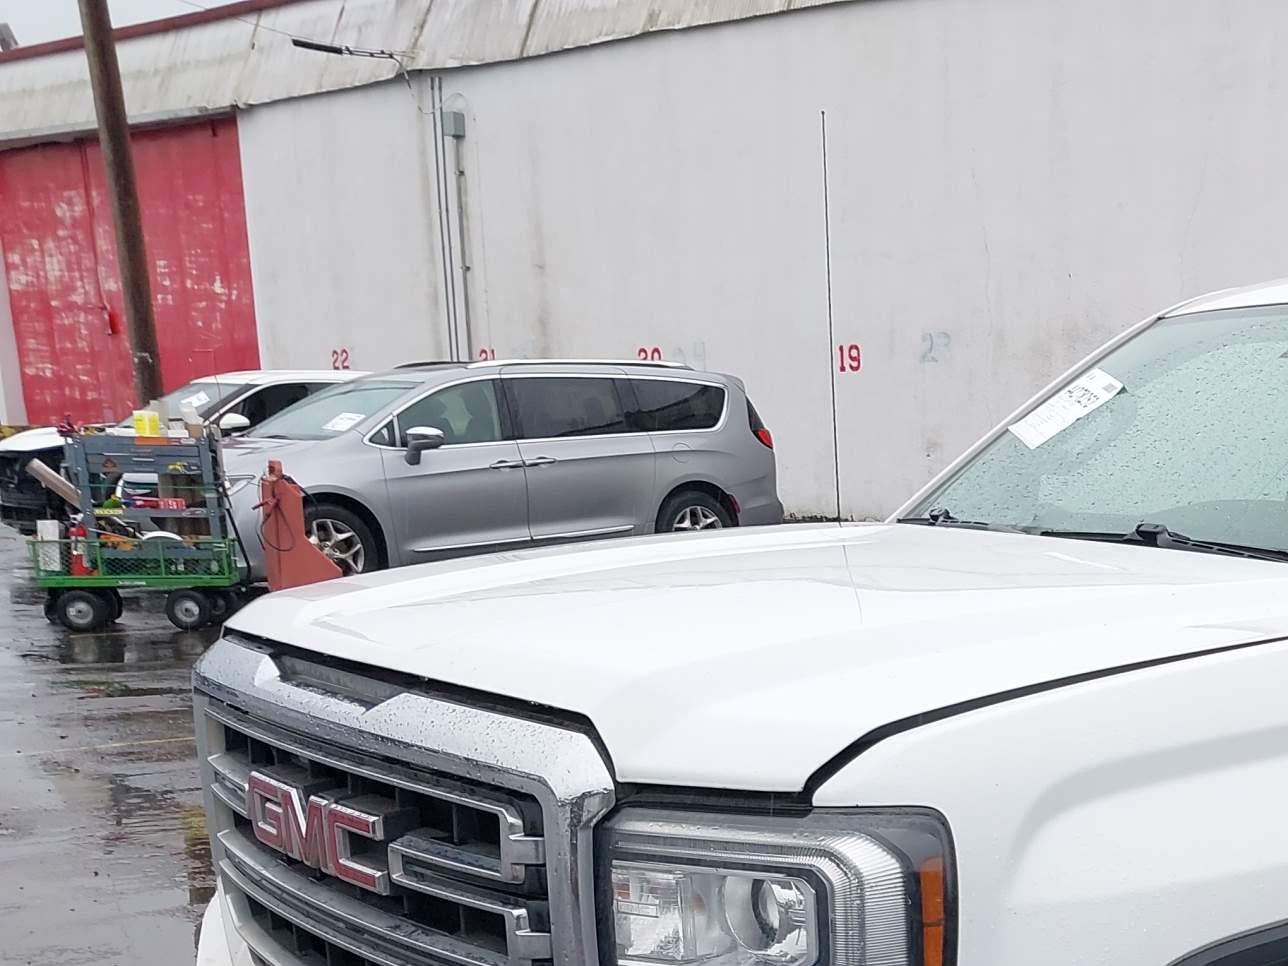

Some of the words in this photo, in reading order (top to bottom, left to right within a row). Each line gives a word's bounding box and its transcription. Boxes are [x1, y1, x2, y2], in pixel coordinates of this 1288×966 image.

[331, 349, 350, 370] 22
[838, 344, 861, 372] 19
[247, 768, 390, 896] GMC
